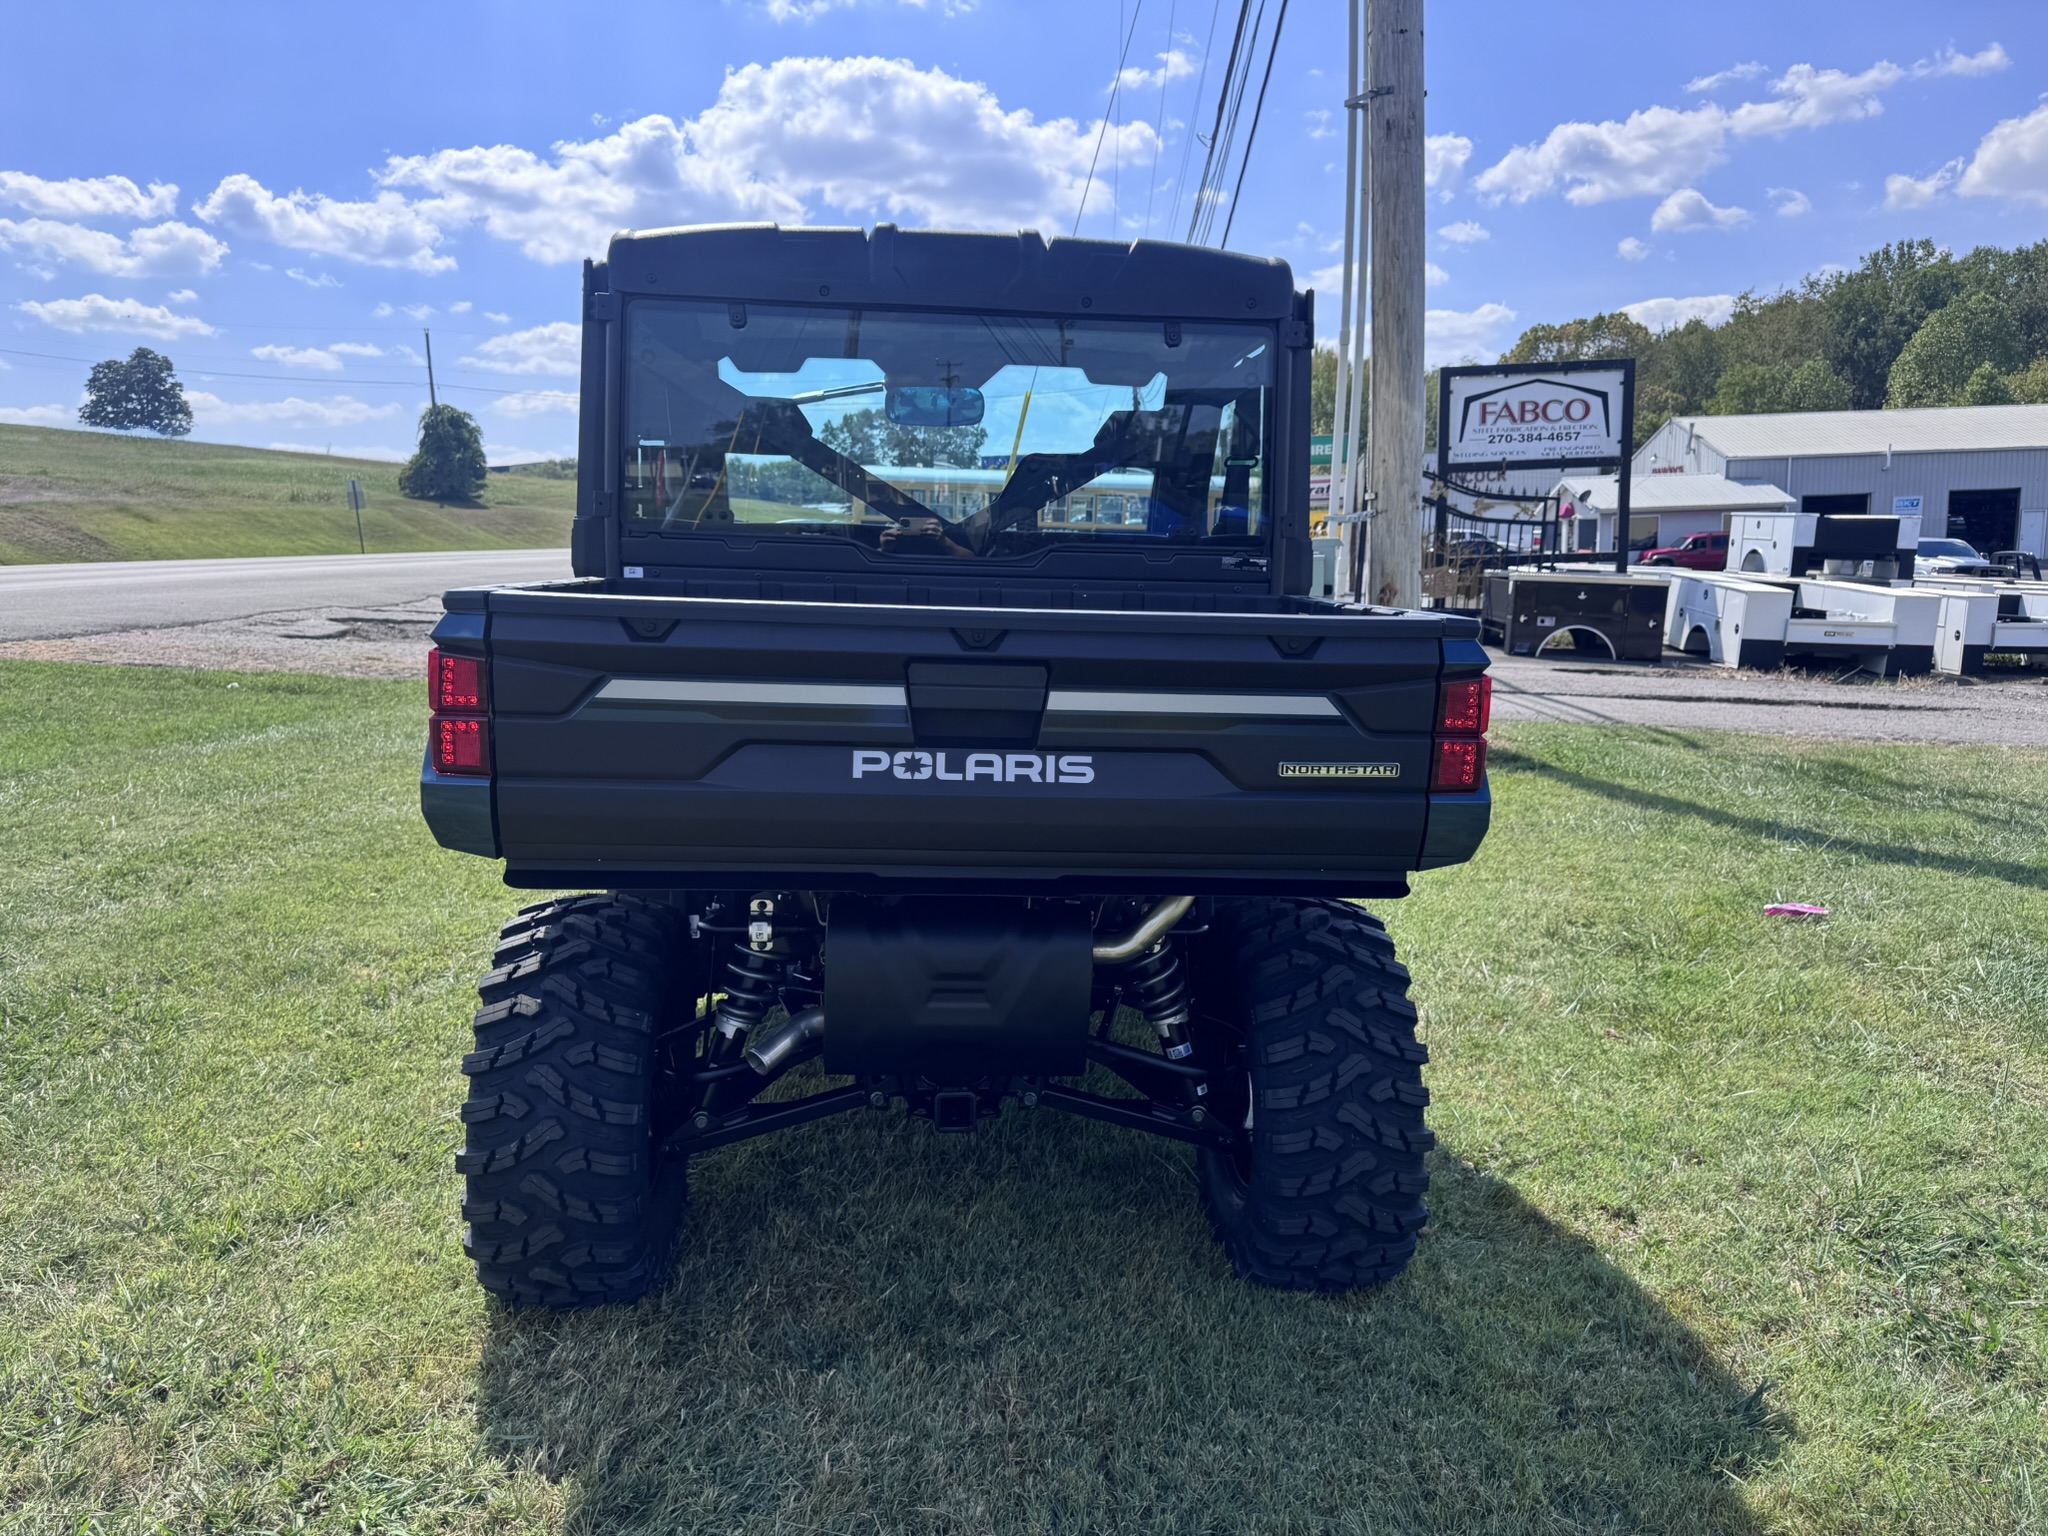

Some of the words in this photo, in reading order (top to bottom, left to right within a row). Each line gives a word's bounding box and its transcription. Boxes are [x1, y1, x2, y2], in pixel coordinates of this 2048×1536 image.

[1479, 398, 1591, 426] FABCO
[1496, 425, 1548, 434] FABRICATION
[1559, 424, 1598, 432] ERECTION
[1488, 432, 1581, 444] 270-384-4657
[1449, 471, 1506, 483] NCOCK
[852, 750, 1095, 783] POLARIS
[1283, 764, 1397, 775] NORTHSTAR
